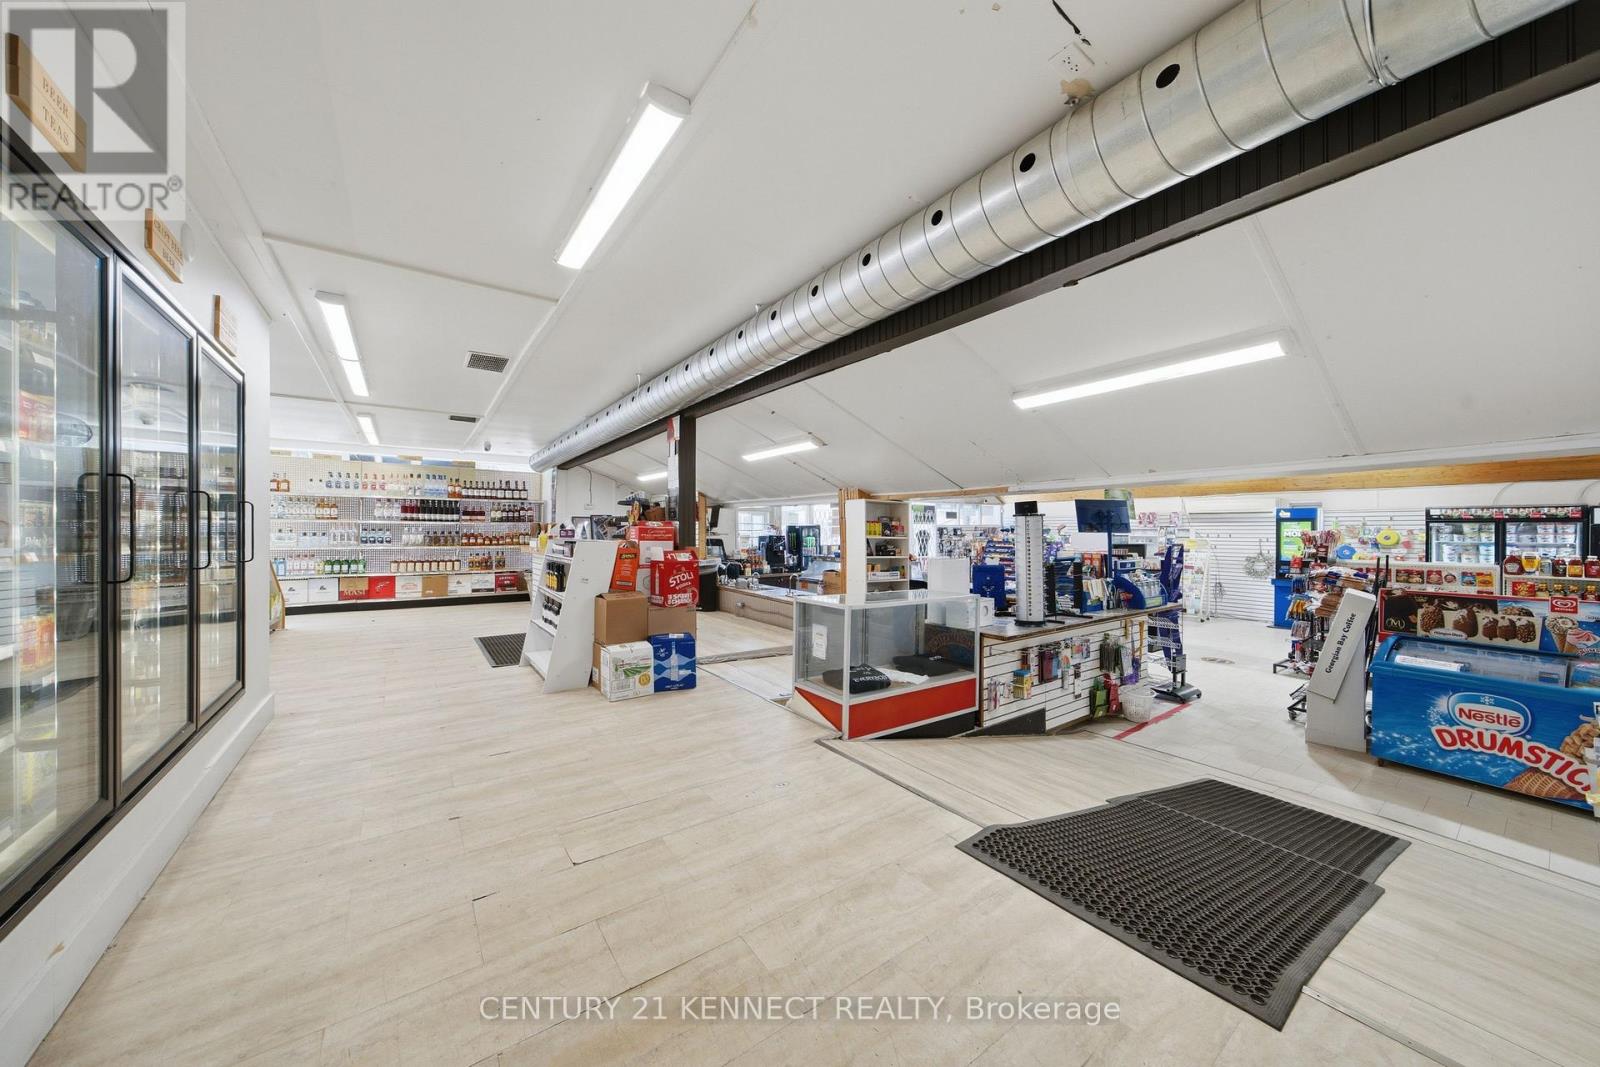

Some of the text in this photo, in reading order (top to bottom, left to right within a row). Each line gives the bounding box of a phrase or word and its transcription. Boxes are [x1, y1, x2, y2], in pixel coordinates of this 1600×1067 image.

[42, 77, 69, 119] BEER
[42, 106, 69, 146] TEAS
[669, 571, 694, 588] STOLI
[1325, 612, 1357, 674] Georgian Bay Coffee
[1434, 727, 1592, 793] DRUMSTIC
